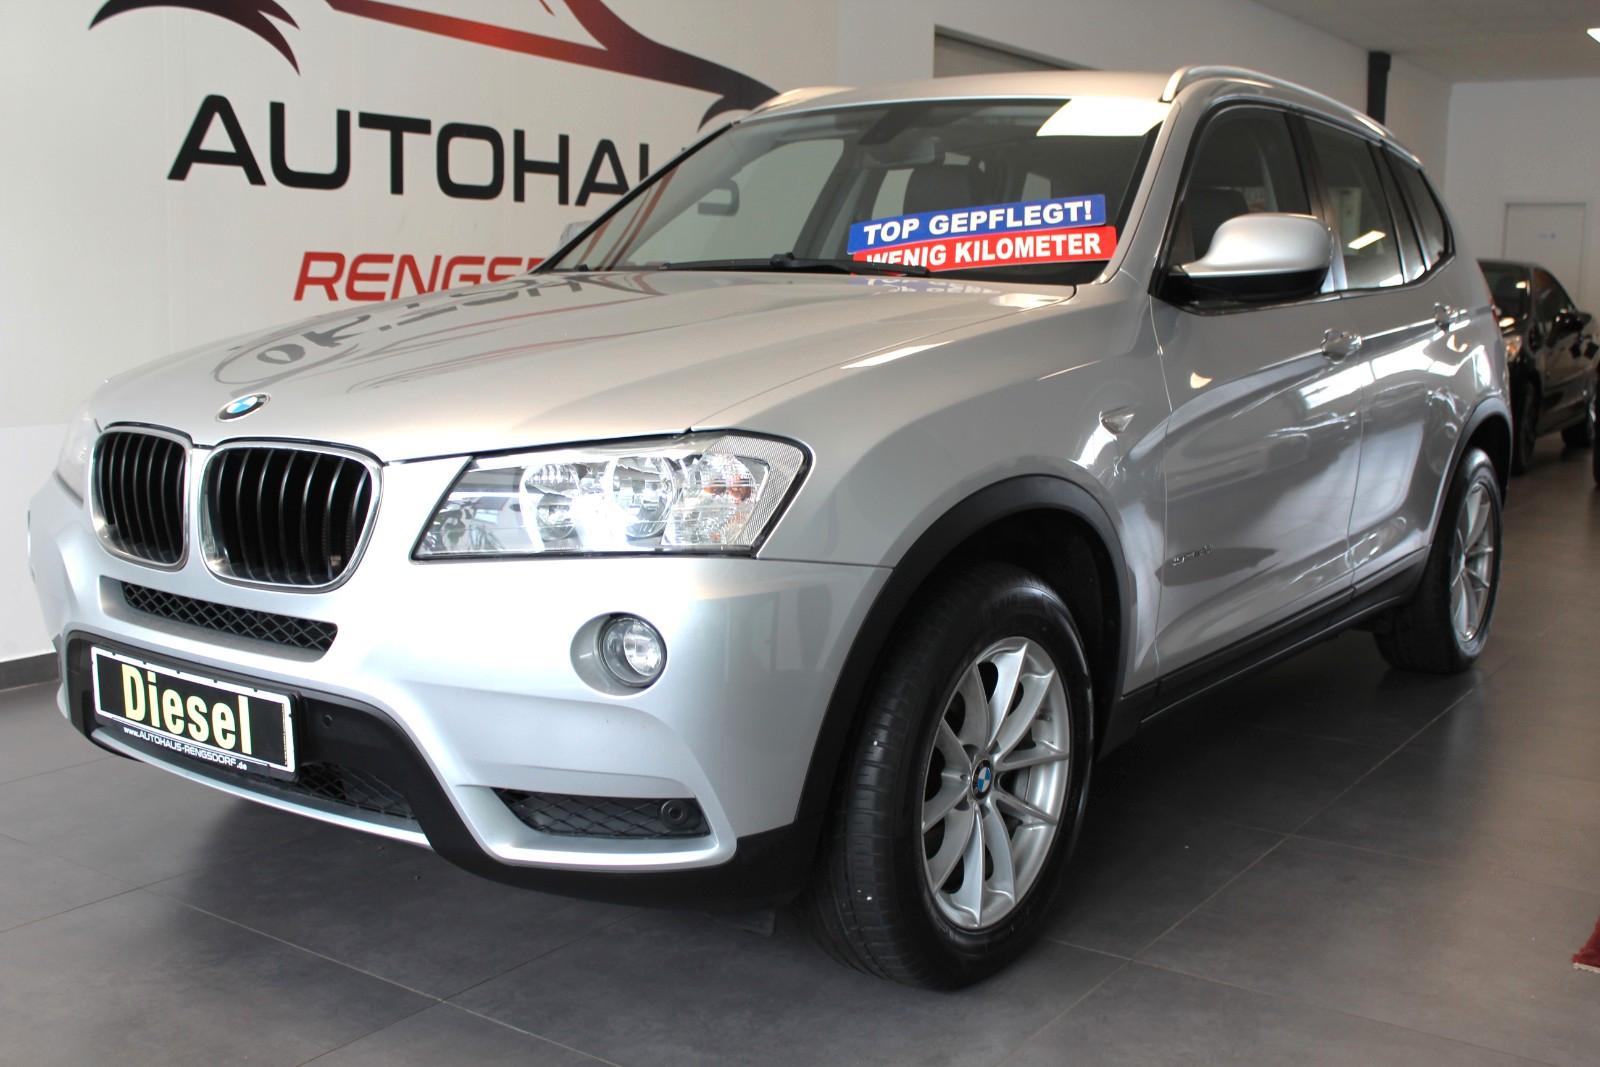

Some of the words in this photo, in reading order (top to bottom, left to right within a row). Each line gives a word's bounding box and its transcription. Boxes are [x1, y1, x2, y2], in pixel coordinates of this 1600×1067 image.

[863, 218, 920, 246] TOP
[928, 200, 1092, 235] GEPFLEGT!
[866, 245, 947, 267] WENIG
[954, 232, 1101, 263] KILOMETER
[121, 663, 252, 755] Diesel
